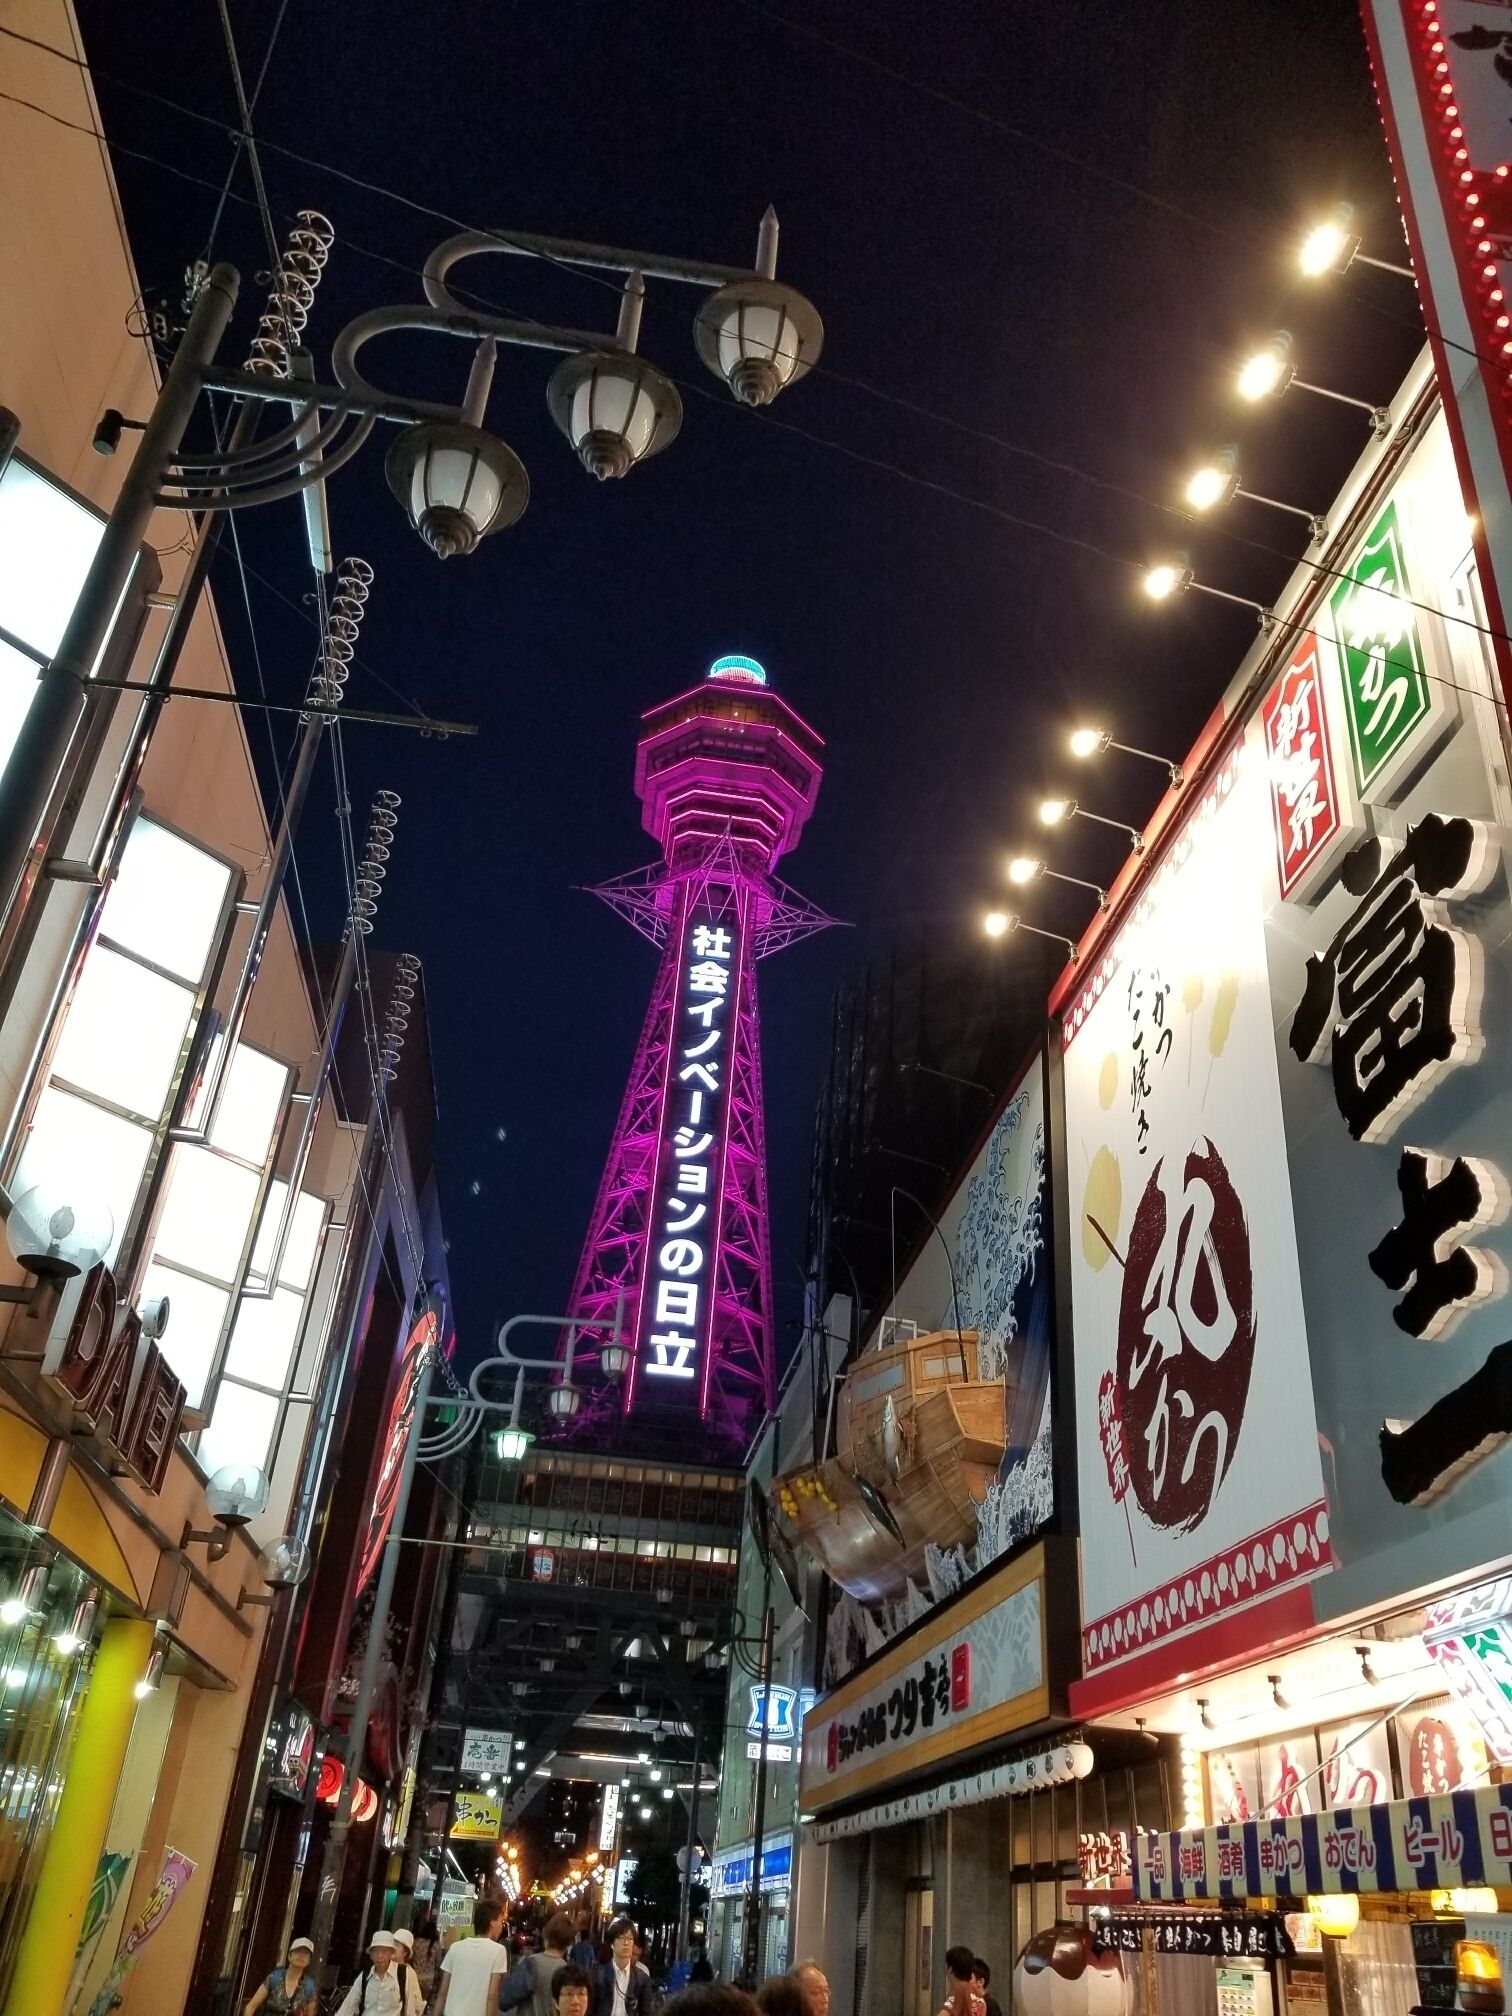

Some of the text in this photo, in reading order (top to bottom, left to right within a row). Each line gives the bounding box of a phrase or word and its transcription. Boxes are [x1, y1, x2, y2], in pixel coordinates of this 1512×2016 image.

[1127, 968, 1153, 1155] たこ焼き
[646, 925, 732, 1377] 社会イノベーションの日立
[1101, 1382, 1129, 1494] 新世界
[458, 1796, 498, 1828] 串かつ
[1144, 1849, 1165, 1881] 一品
[1180, 1845, 1205, 1880] 海鮮
[1217, 1842, 1244, 1877] 酒肴
[1260, 1838, 1303, 1873] 串かつ
[1325, 1830, 1374, 1868] おでん
[1404, 1820, 1461, 1862] ビール
